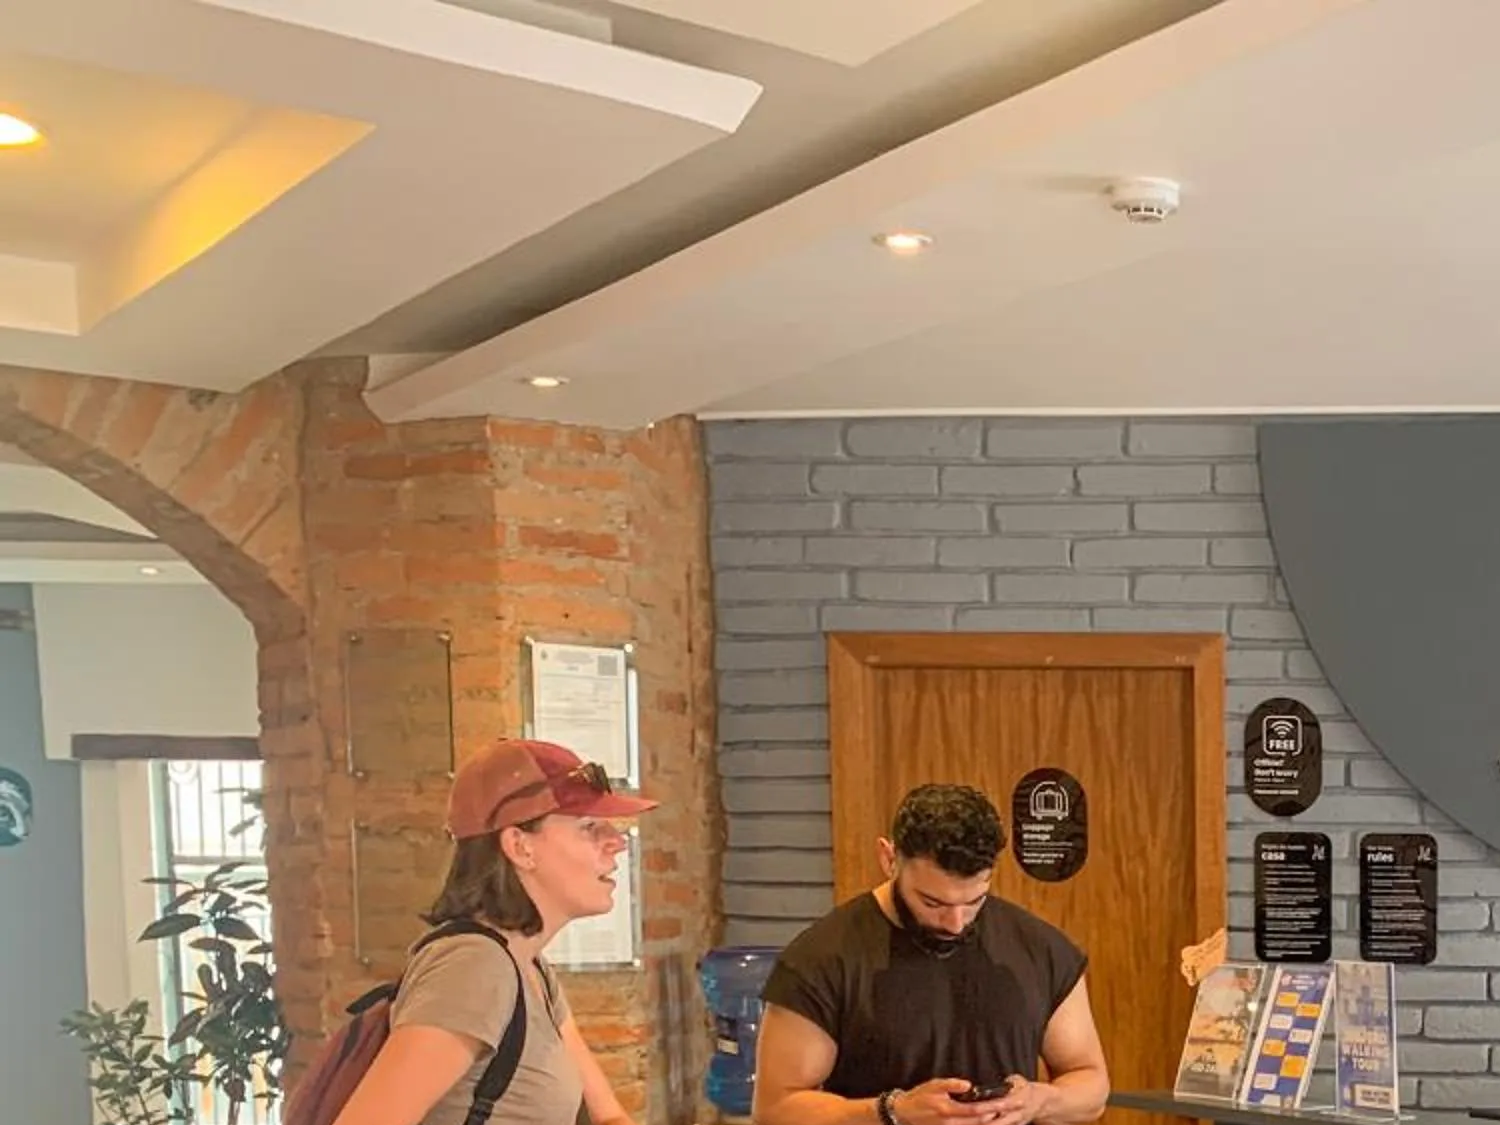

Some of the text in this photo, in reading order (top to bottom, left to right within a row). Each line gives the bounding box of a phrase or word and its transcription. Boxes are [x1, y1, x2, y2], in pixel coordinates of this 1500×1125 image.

[1269, 739, 1295, 751] FREE
[1261, 851, 1286, 861] casa
[1367, 851, 1394, 863] rules
